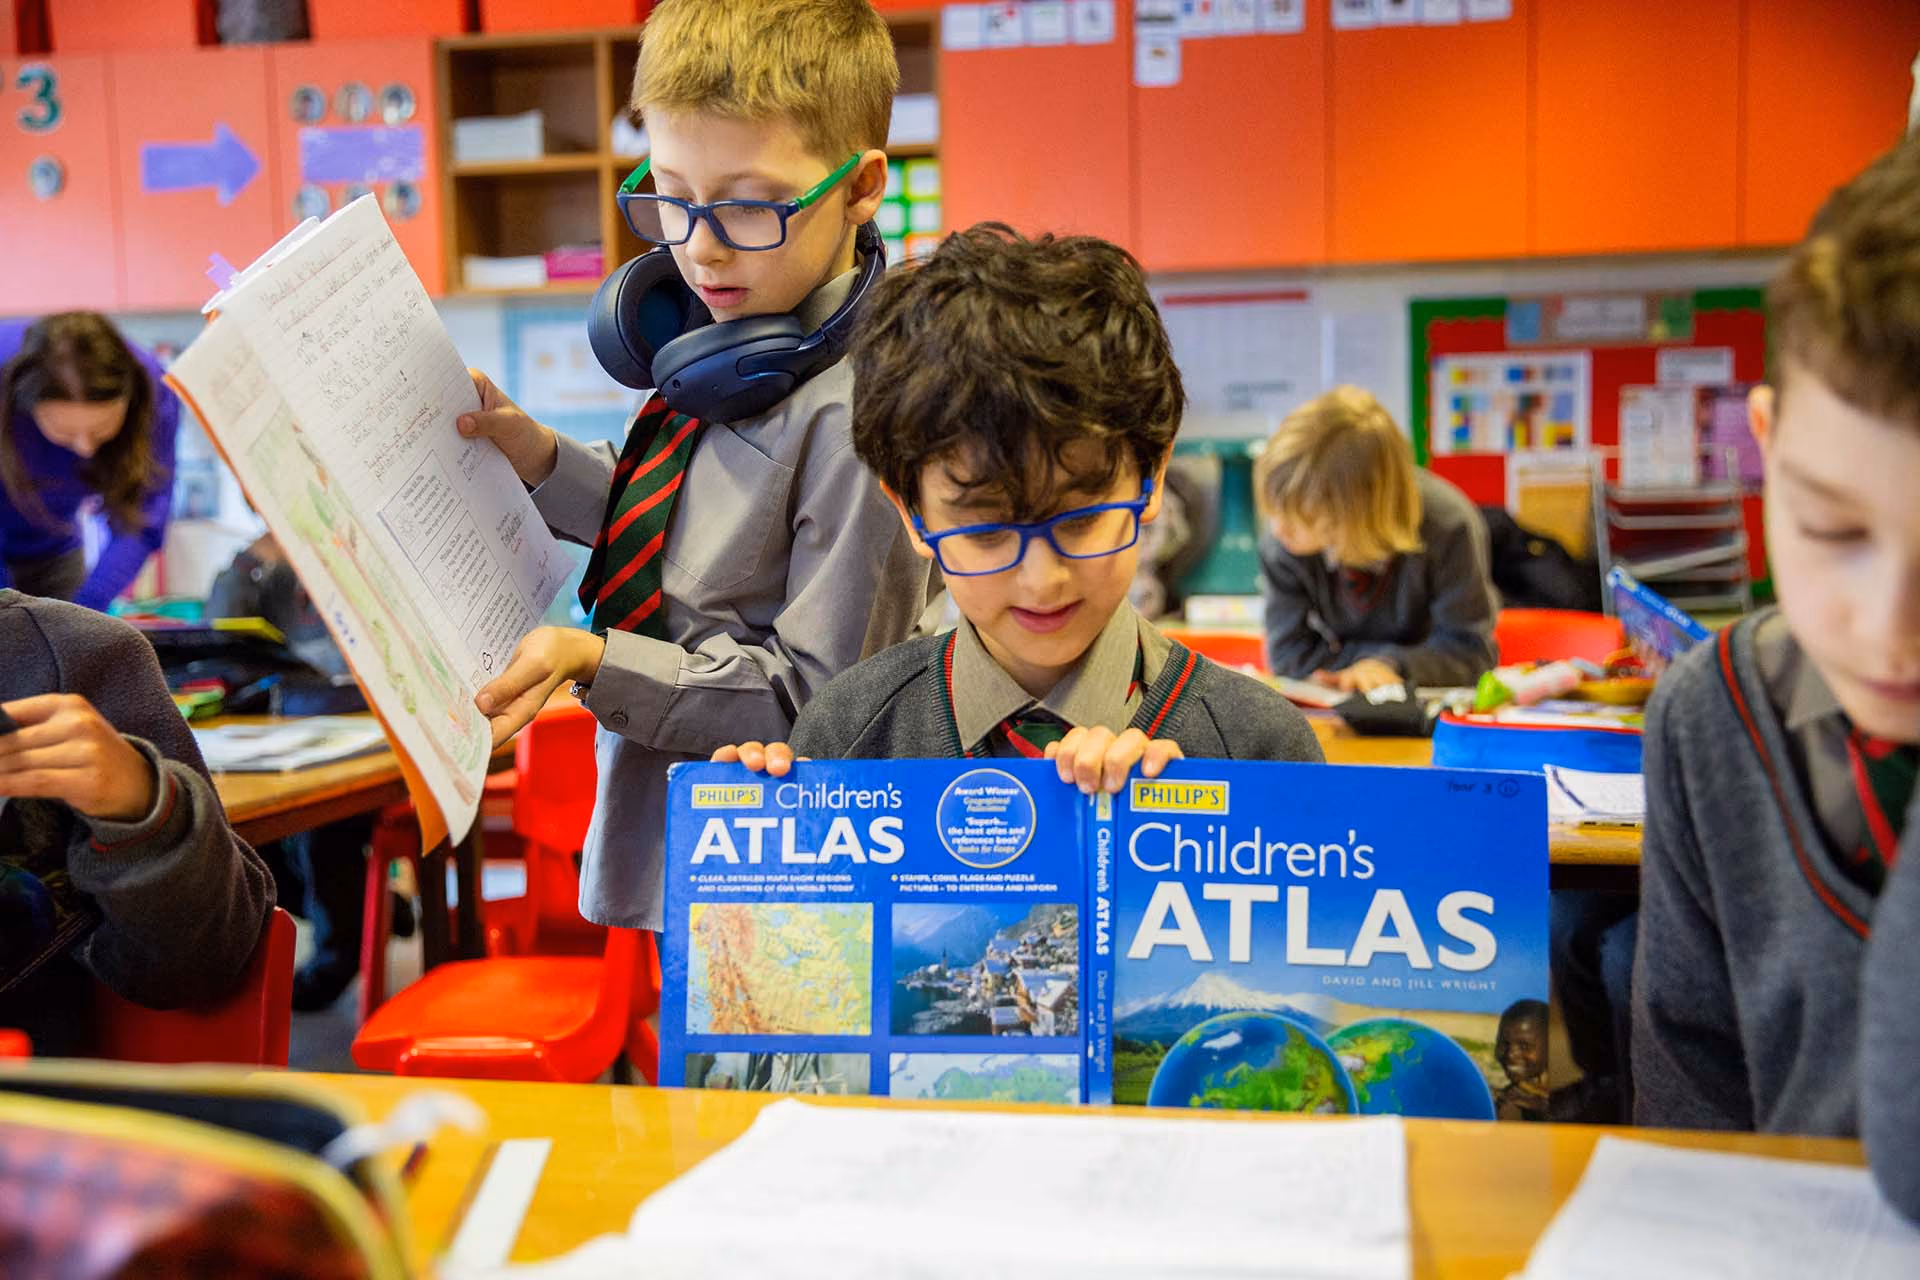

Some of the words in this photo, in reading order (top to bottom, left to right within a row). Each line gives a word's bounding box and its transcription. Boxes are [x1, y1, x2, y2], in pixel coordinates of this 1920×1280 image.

[17, 64, 63, 134] 3
[699, 789, 757, 802] PHILIP'S
[775, 782, 904, 810] Children's
[954, 786, 984, 796] Award
[985, 786, 1020, 796] Winner
[1139, 786, 1221, 805] PHILIP'S
[690, 816, 905, 865] ATLAS
[948, 826, 964, 836] the
[964, 826, 984, 836] best
[986, 826, 1008, 836] atlas
[1009, 826, 1026, 836] and
[1096, 827, 1111, 893] Children's
[1128, 822, 1376, 879] Children's
[766, 874, 788, 883] MAPS
[790, 874, 814, 883] SHOW
[816, 874, 852, 883] REGIONS
[960, 874, 984, 883] FLAGS
[985, 874, 1003, 883] AND
[1004, 874, 1035, 883] PUZZLE
[697, 884, 716, 893] AND
[717, 884, 762, 893] COUNTRIES
[764, 884, 775, 893] OF
[777, 884, 795, 893] OUR
[796, 884, 826, 893] WORLD
[827, 884, 855, 893] TODAY
[900, 884, 938, 893] PICTURES
[947, 884, 957, 893] TO
[959, 884, 1004, 893] ENTERTAIN
[1005, 884, 1024, 893] AND
[1025, 884, 1058, 893] INFORM
[1096, 897, 1111, 956] ATLAS
[1127, 881, 1498, 972] ATLAS
[1096, 970, 1108, 1000] David
[1322, 975, 1366, 986] DAVID
[1371, 977, 1402, 988] AND
[1408, 979, 1434, 990] JILL
[1440, 979, 1497, 991] WRIGHT
